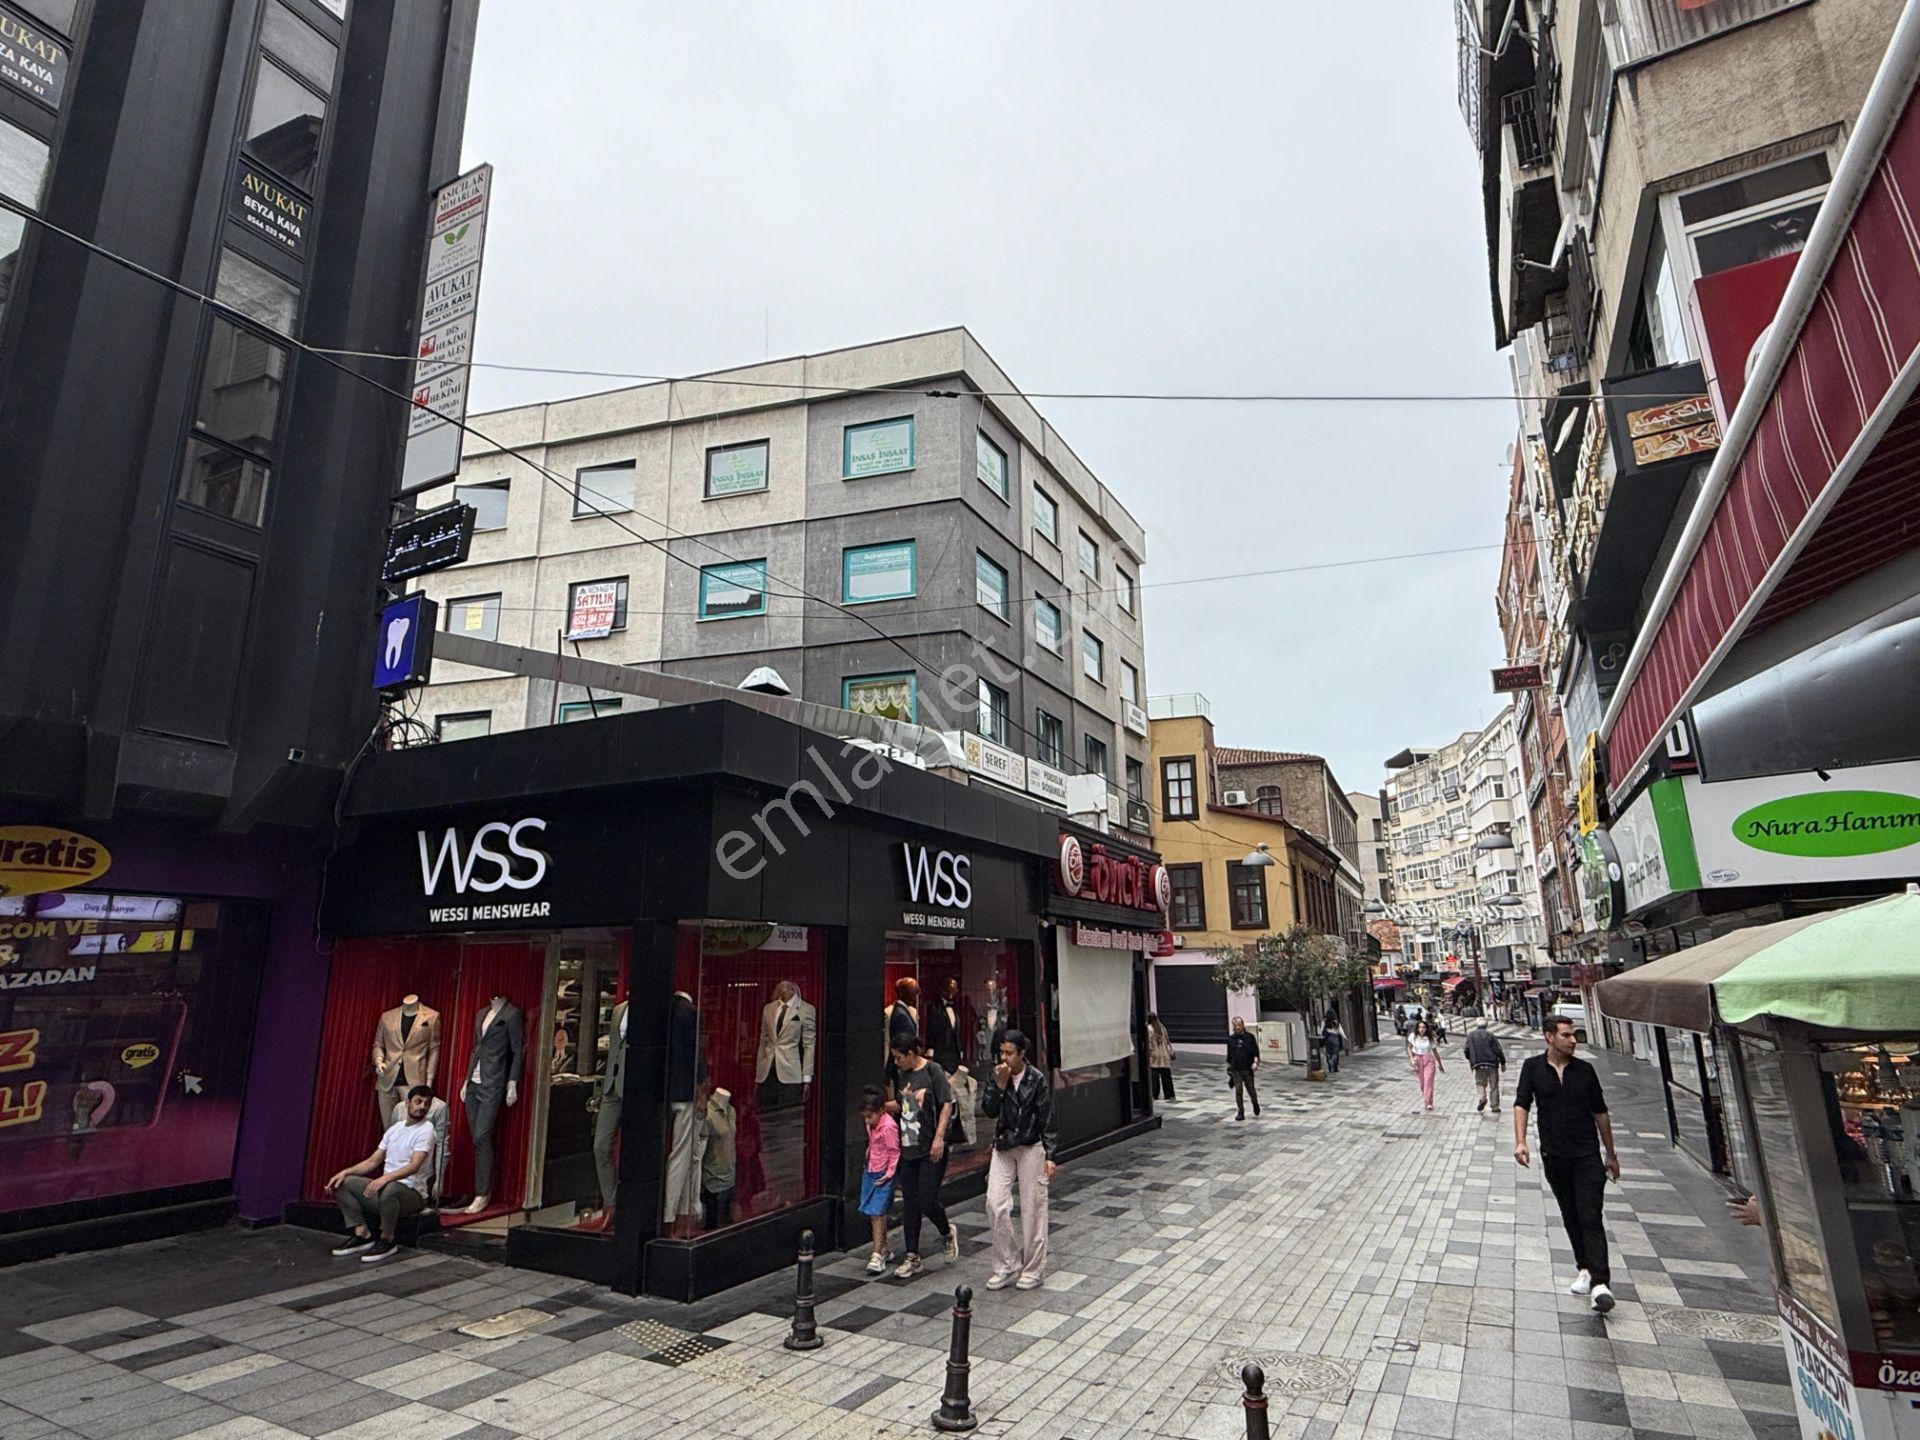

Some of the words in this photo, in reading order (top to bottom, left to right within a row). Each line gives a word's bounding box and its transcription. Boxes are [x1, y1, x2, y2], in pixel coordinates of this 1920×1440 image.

[19, 55, 54, 85] KAYA
[241, 173, 307, 221] AVUKAT
[243, 194, 275, 222] BEYZA
[276, 214, 301, 238] KAYA
[427, 269, 475, 305] AVUKAT
[425, 302, 449, 318] BEYZA
[451, 291, 472, 306] KAYA
[577, 592, 614, 608] SATILIK
[0, 836, 97, 869] ratis
[417, 817, 547, 896] WSS
[903, 841, 972, 909] WSS
[429, 906, 469, 923] WESSI
[471, 901, 551, 921] MENSWEAR
[903, 912, 926, 926] WESSI
[927, 914, 966, 930] MENSWEAR
[65, 920, 98, 936] VE
[125, 1046, 157, 1060] gratis
[1790, 1331, 1850, 1415] TRABZON
